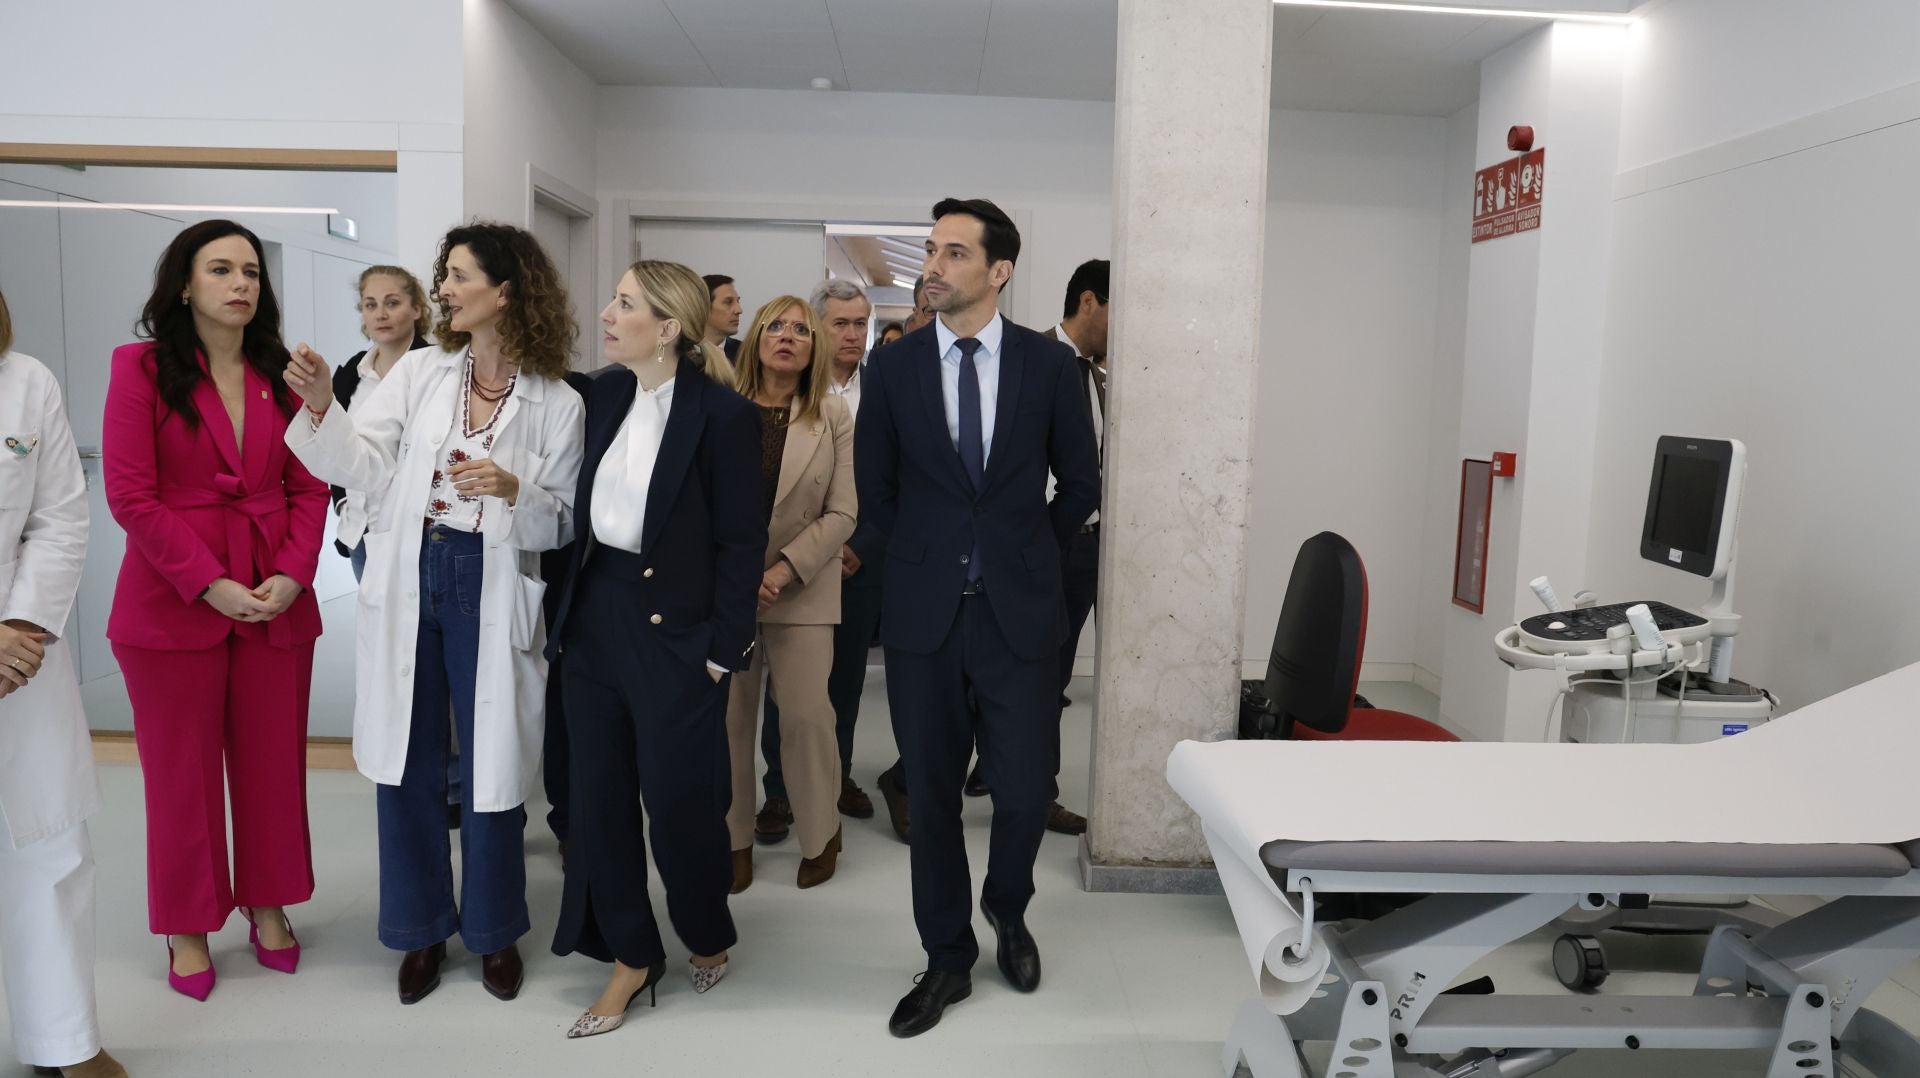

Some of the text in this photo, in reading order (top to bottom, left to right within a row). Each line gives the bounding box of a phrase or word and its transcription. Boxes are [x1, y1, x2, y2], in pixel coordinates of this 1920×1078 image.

[1494, 214, 1515, 227] PULSADOR
[1518, 207, 1540, 221] AVISADOR
[1472, 222, 1493, 239] EXTINTOR
[1519, 217, 1538, 231] SONORO
[1390, 971, 1426, 1020] PRIM
